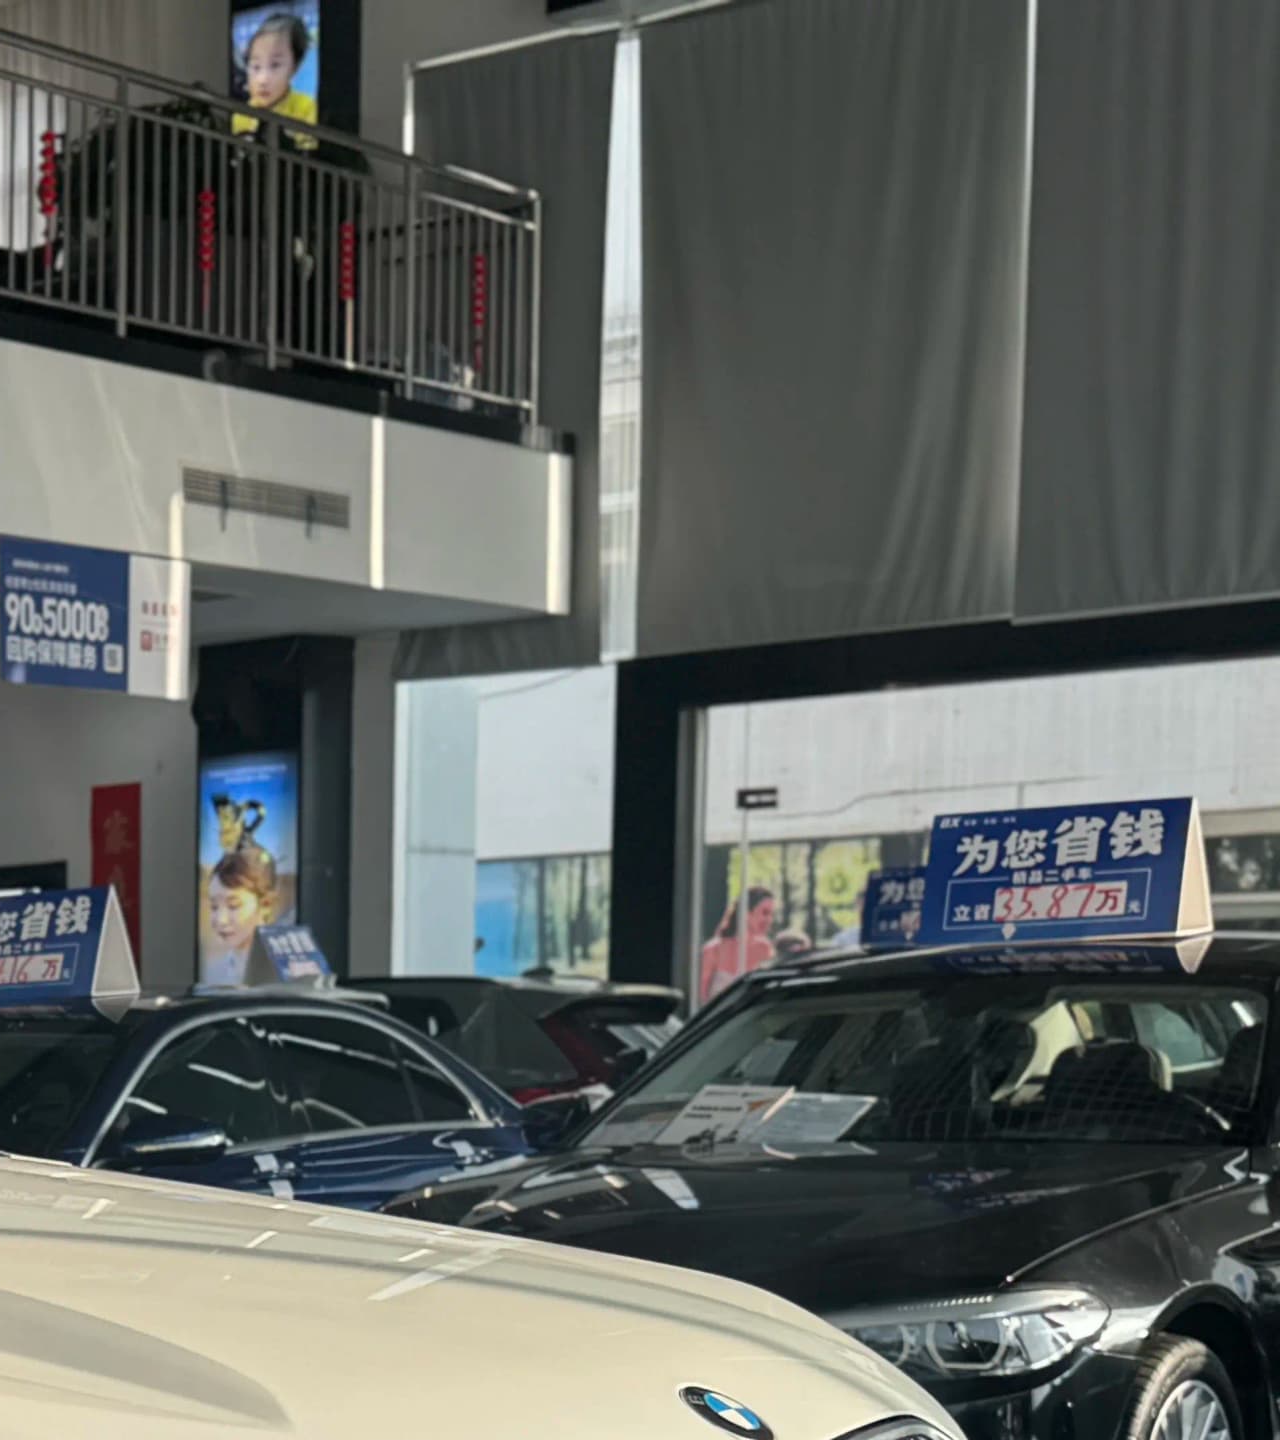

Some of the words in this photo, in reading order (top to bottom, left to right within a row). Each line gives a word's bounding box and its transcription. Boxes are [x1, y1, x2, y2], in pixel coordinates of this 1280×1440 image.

[952, 808, 1166, 877] 为您省钱
[952, 903, 992, 923] 立省
